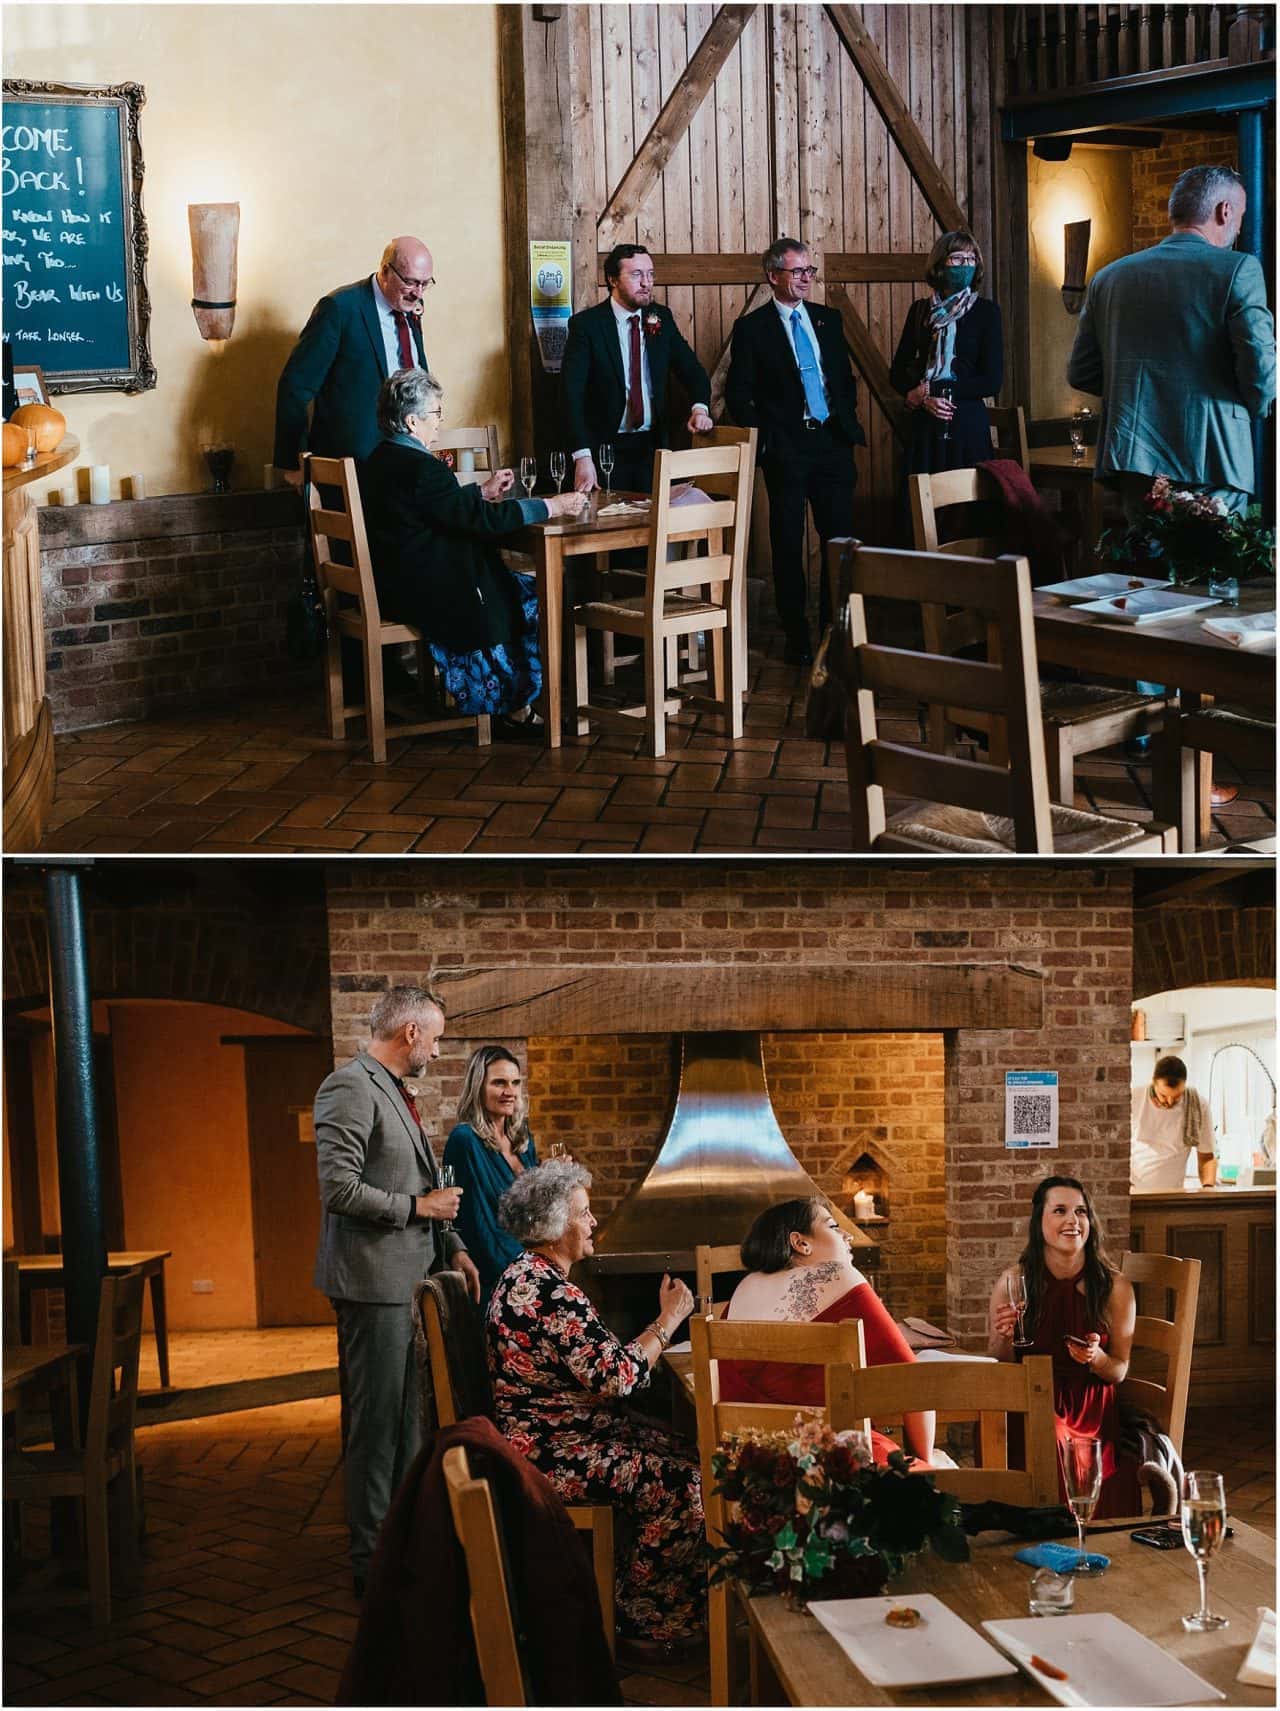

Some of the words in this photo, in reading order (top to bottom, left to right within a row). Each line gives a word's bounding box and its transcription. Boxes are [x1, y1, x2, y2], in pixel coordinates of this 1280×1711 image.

[61, 209, 90, 224] HOW
[32, 228, 52, 242] WE
[59, 231, 86, 245] ARE
[15, 329, 42, 342] TAKE
